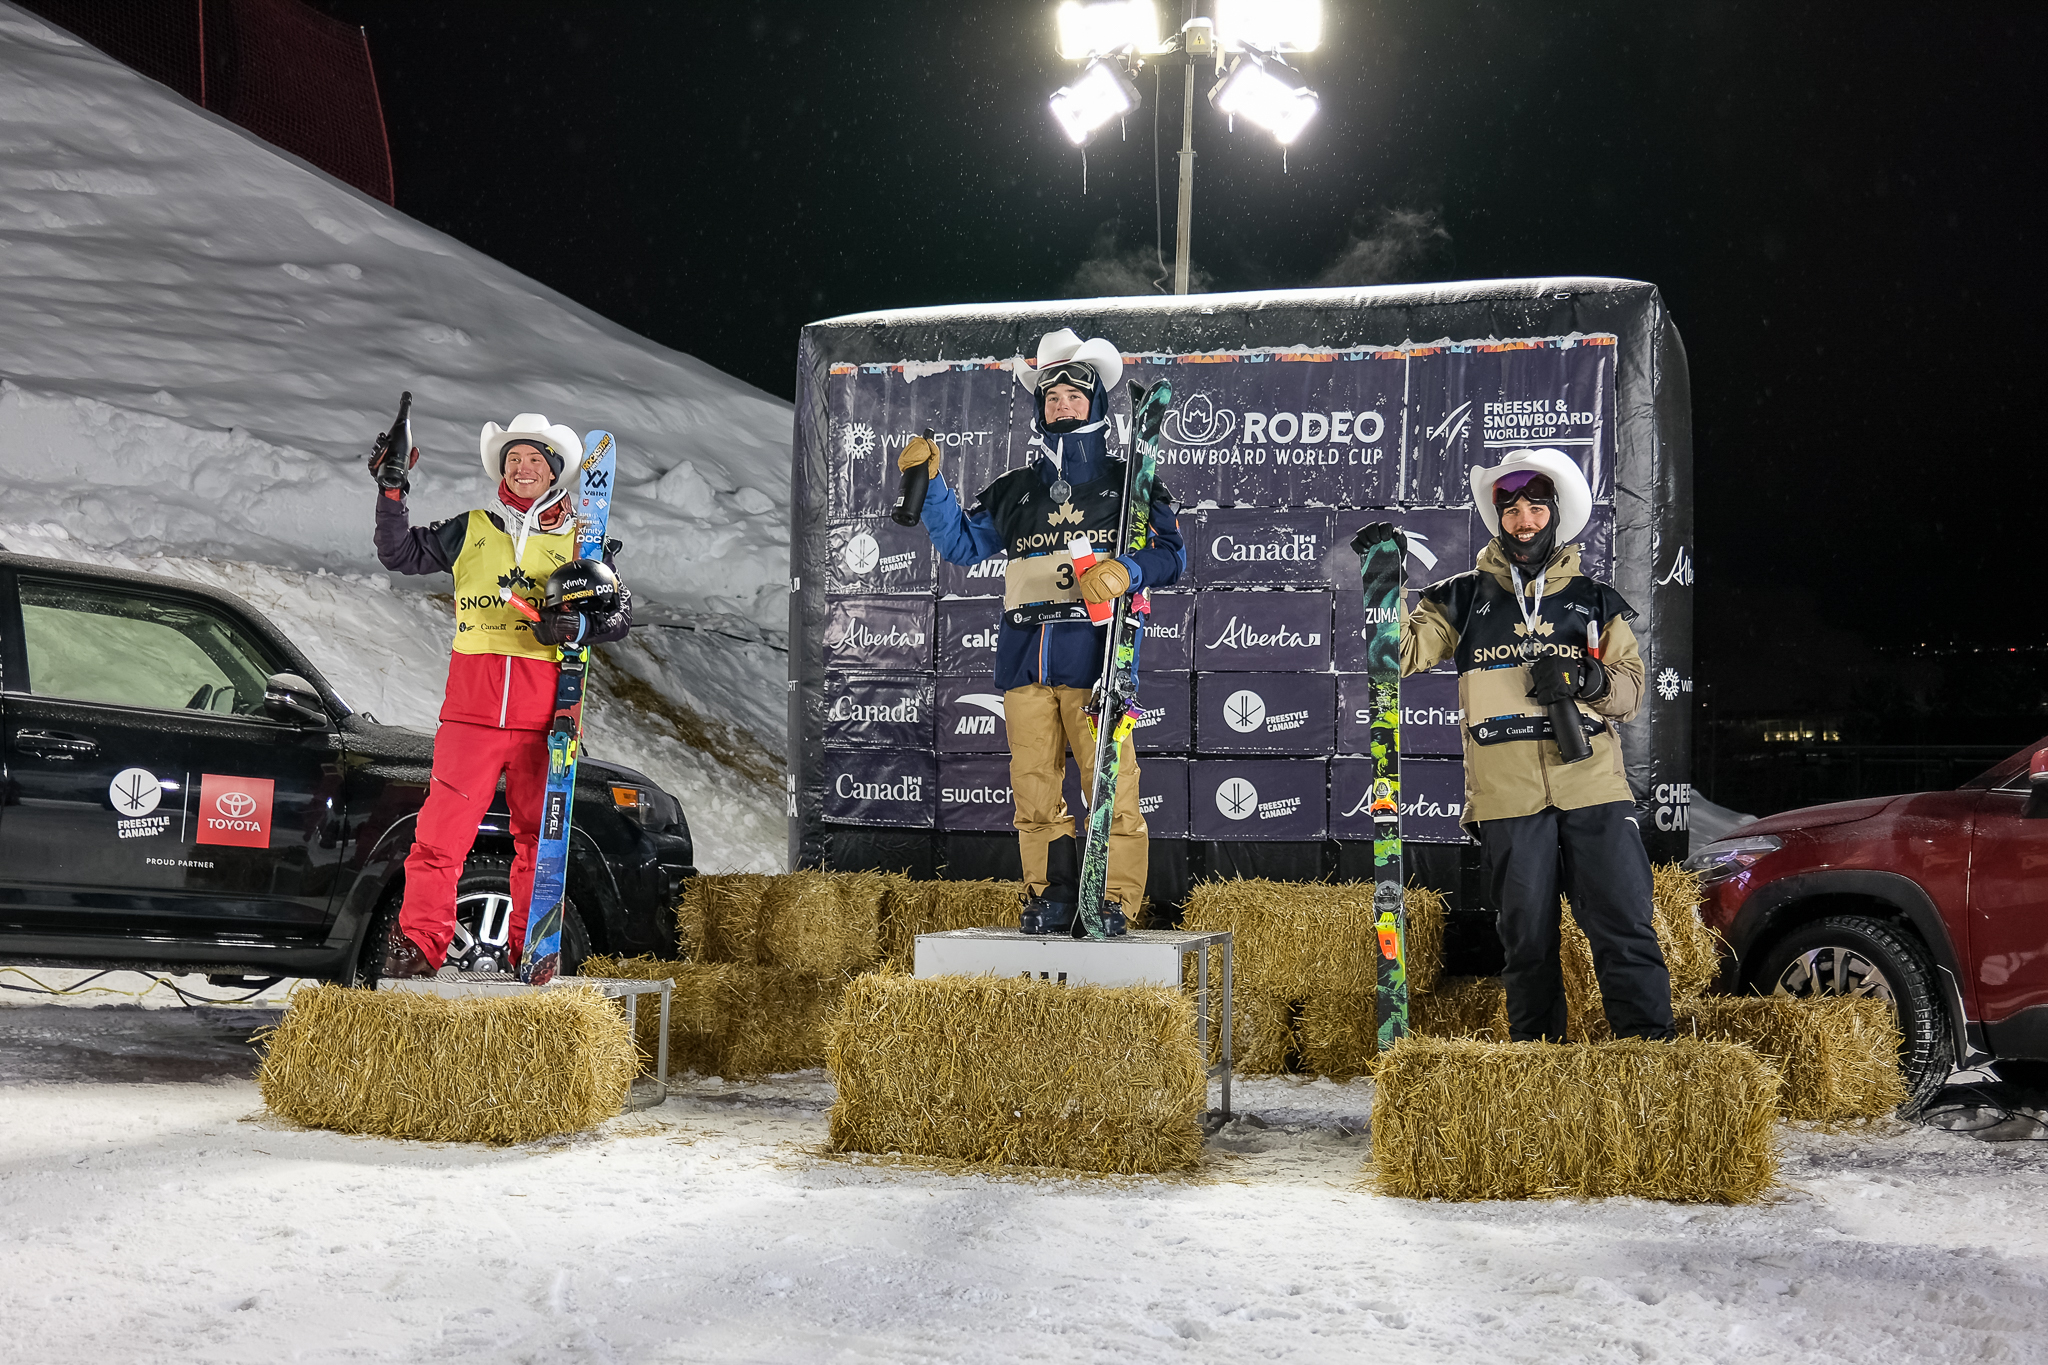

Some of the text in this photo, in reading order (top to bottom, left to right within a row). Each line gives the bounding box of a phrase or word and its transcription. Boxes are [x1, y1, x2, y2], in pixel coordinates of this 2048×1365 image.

[1484, 399, 1568, 415] FREESKI &
[1242, 411, 1385, 444] RODEO
[1484, 412, 1594, 428] SNOWBOARD
[1484, 427, 1557, 440] WORLD CUP
[582, 433, 612, 472] ROCKSTAR
[1136, 438, 1157, 460] ZUMA
[1157, 448, 1384, 465] SNOWBOARD WORLD CUP
[578, 526, 602, 536] xfinity
[1016, 532, 1060, 552] SNOW
[1211, 535, 1317, 561] Canada
[879, 551, 916, 566] FREESTYLE
[880, 561, 909, 573] CANADA
[966, 559, 1008, 578] ANTA
[562, 578, 587, 590] xfinity
[1055, 563, 1075, 590] 3
[460, 595, 507, 611] SNOW
[562, 589, 595, 602] ROCKSTAR
[1365, 607, 1399, 624] ZUMA
[830, 617, 920, 648] Alberta
[1205, 616, 1316, 649] Alberta
[1474, 643, 1528, 663] SNOW
[835, 696, 919, 722] Canada
[1265, 710, 1309, 724] FREESTYLE
[955, 716, 995, 735] ANTA
[1267, 721, 1299, 733] CANADA
[836, 773, 922, 801] Canada
[1258, 797, 1301, 811] FREESTYLE
[549, 797, 561, 834] LEVEL
[1259, 808, 1292, 820] CANADA
[117, 816, 170, 829] FREESTYLE
[207, 818, 262, 833] TOYOTA
[118, 827, 159, 839] CANADA
[146, 857, 214, 869] PROUD PARTNER
